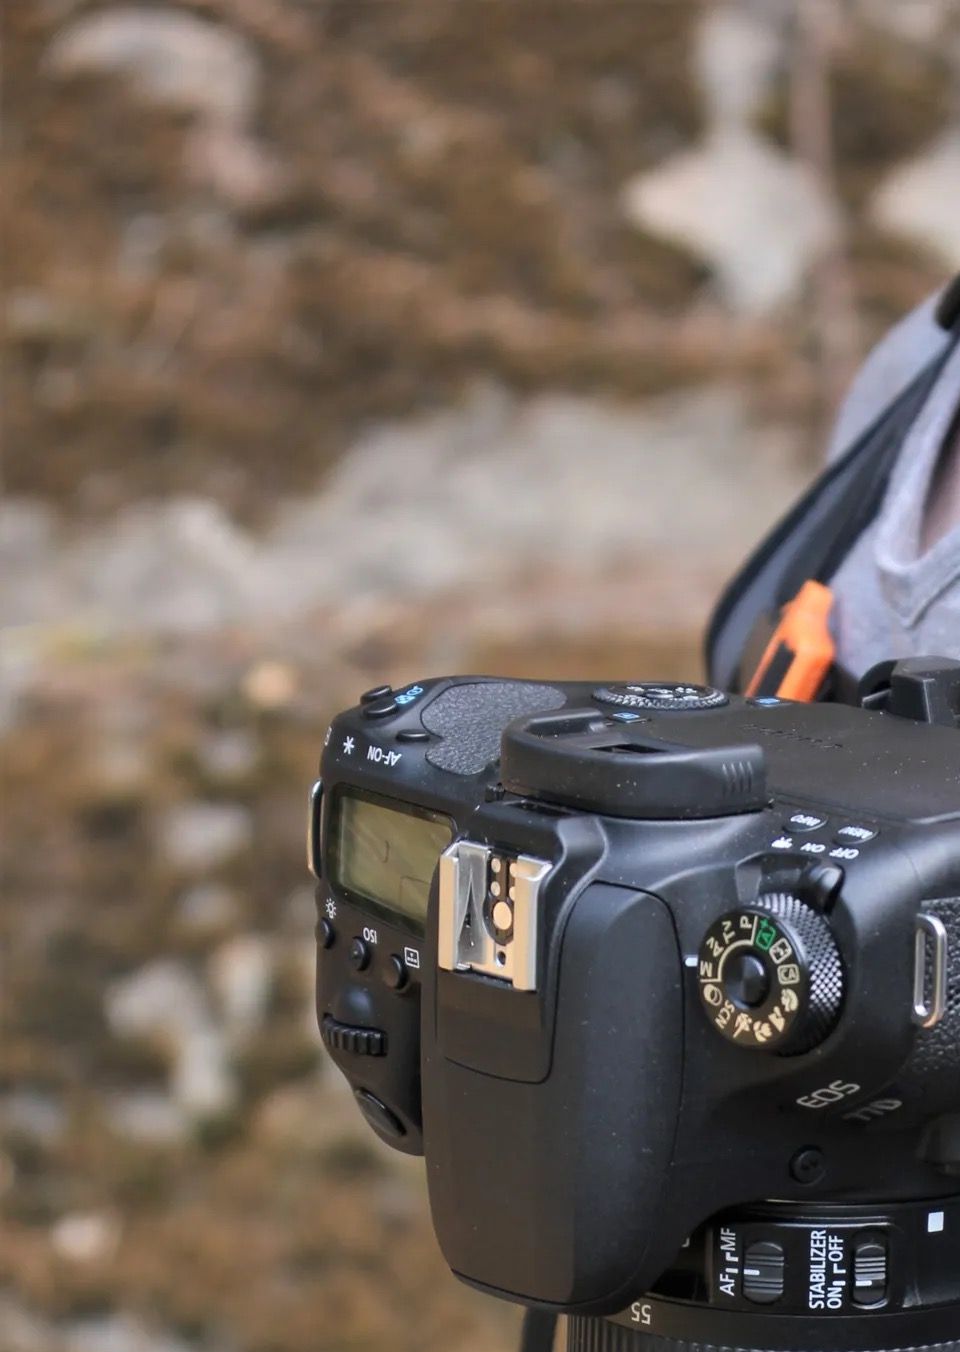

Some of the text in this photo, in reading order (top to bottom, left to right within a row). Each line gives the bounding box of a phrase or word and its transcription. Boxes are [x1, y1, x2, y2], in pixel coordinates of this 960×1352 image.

[367, 745, 402, 767] AF-ON
[800, 842, 826, 853] ON
[829, 847, 860, 859] OFF
[739, 915, 752, 929] P
[363, 927, 377, 944] ISO
[700, 960, 713, 977] M
[715, 1000, 735, 1029] SCN
[796, 1080, 861, 1108] EOS
[720, 1227, 737, 1251] MF
[828, 1235, 845, 1262] OFF
[808, 1229, 827, 1309] STABILIZER
[719, 1273, 735, 1296] AF
[826, 1283, 843, 1309] ON
[631, 1302, 652, 1325] 55
